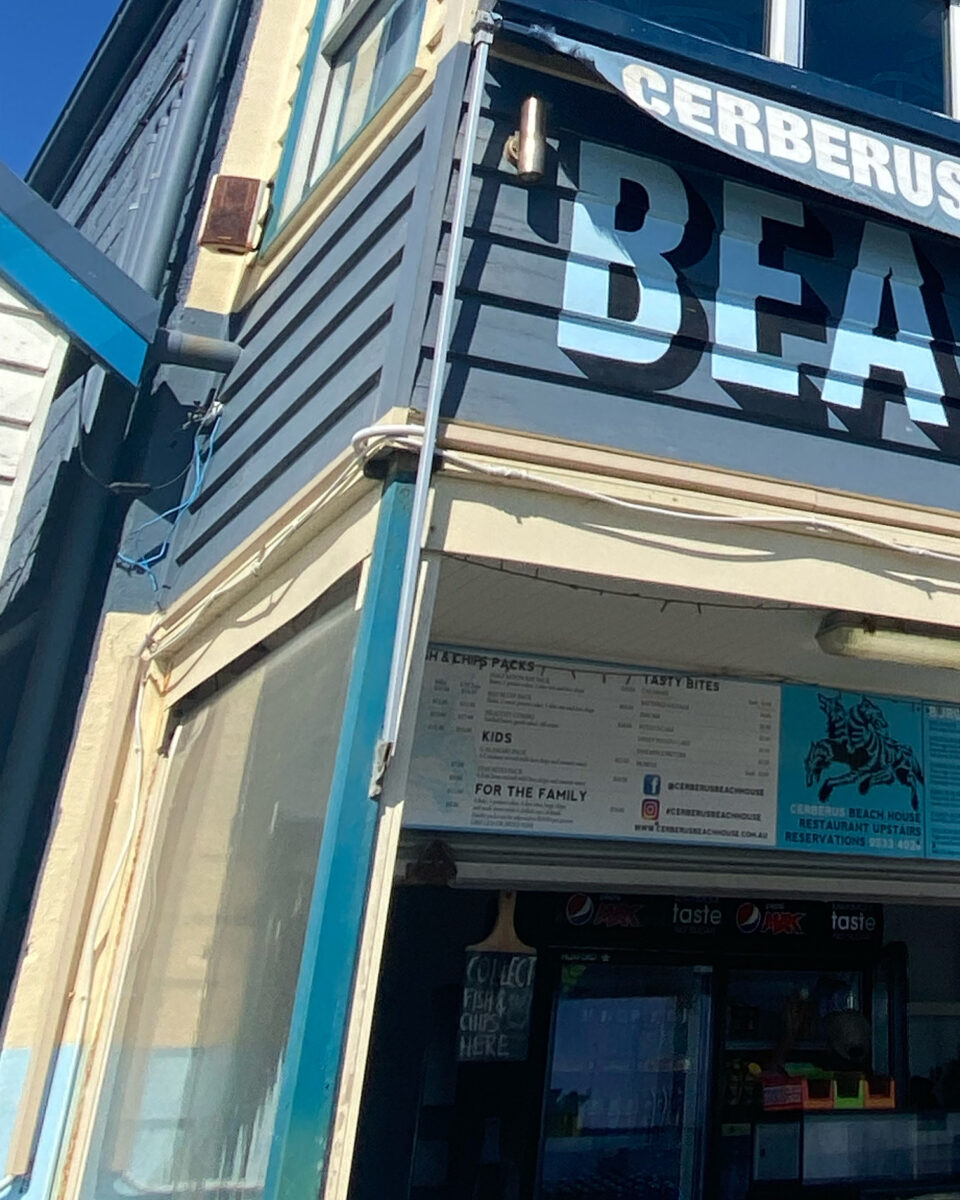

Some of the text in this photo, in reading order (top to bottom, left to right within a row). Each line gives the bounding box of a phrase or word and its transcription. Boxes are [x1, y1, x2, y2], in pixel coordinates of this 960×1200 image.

[441, 650, 450, 662] &
[452, 653, 487, 667] CHIPS
[491, 656, 535, 672] PACKS
[643, 675, 720, 692] TASTY BITES
[481, 729, 513, 744] KIDS
[474, 783, 588, 802] FOR THE FAMILY
[848, 807, 884, 821] BEACH
[887, 811, 921, 824] HOUSE
[798, 817, 921, 837] RESTAURANT UPSTAIRS
[784, 831, 866, 847] RESERVATIONS
[672, 903, 723, 925] taste
[831, 910, 877, 932] taste
[459, 1034, 510, 1058] HERE
